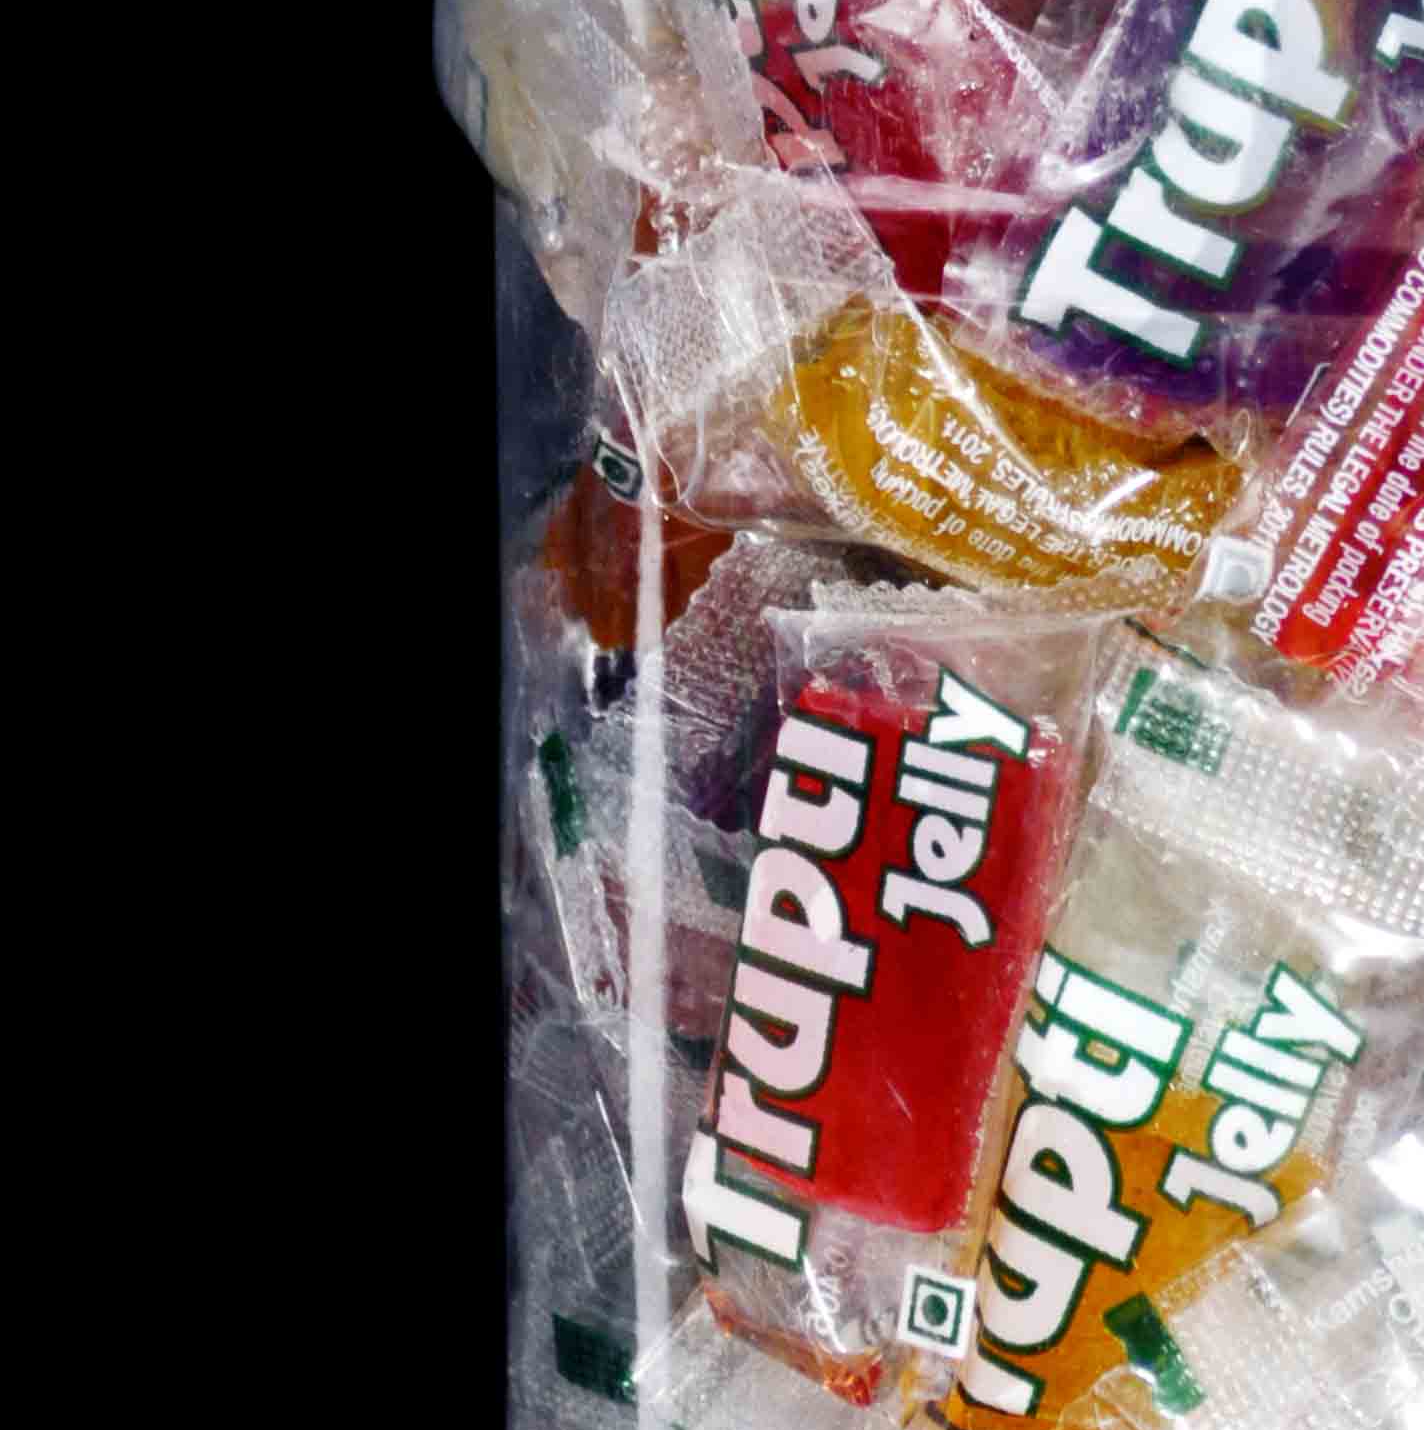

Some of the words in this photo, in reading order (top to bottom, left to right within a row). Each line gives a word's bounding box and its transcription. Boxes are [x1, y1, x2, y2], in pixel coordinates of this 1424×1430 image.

[1357, 398, 1404, 451] THE
[1315, 441, 1379, 523] LEGAL
[1365, 467, 1422, 530] date
[1243, 511, 1340, 647] METROLOGY
[1350, 518, 1392, 556] of
[1297, 539, 1377, 634] packing
[880, 666, 1033, 950] Jelly
[681, 714, 876, 1274] Trupti
[1160, 961, 1368, 1231] Jelly
